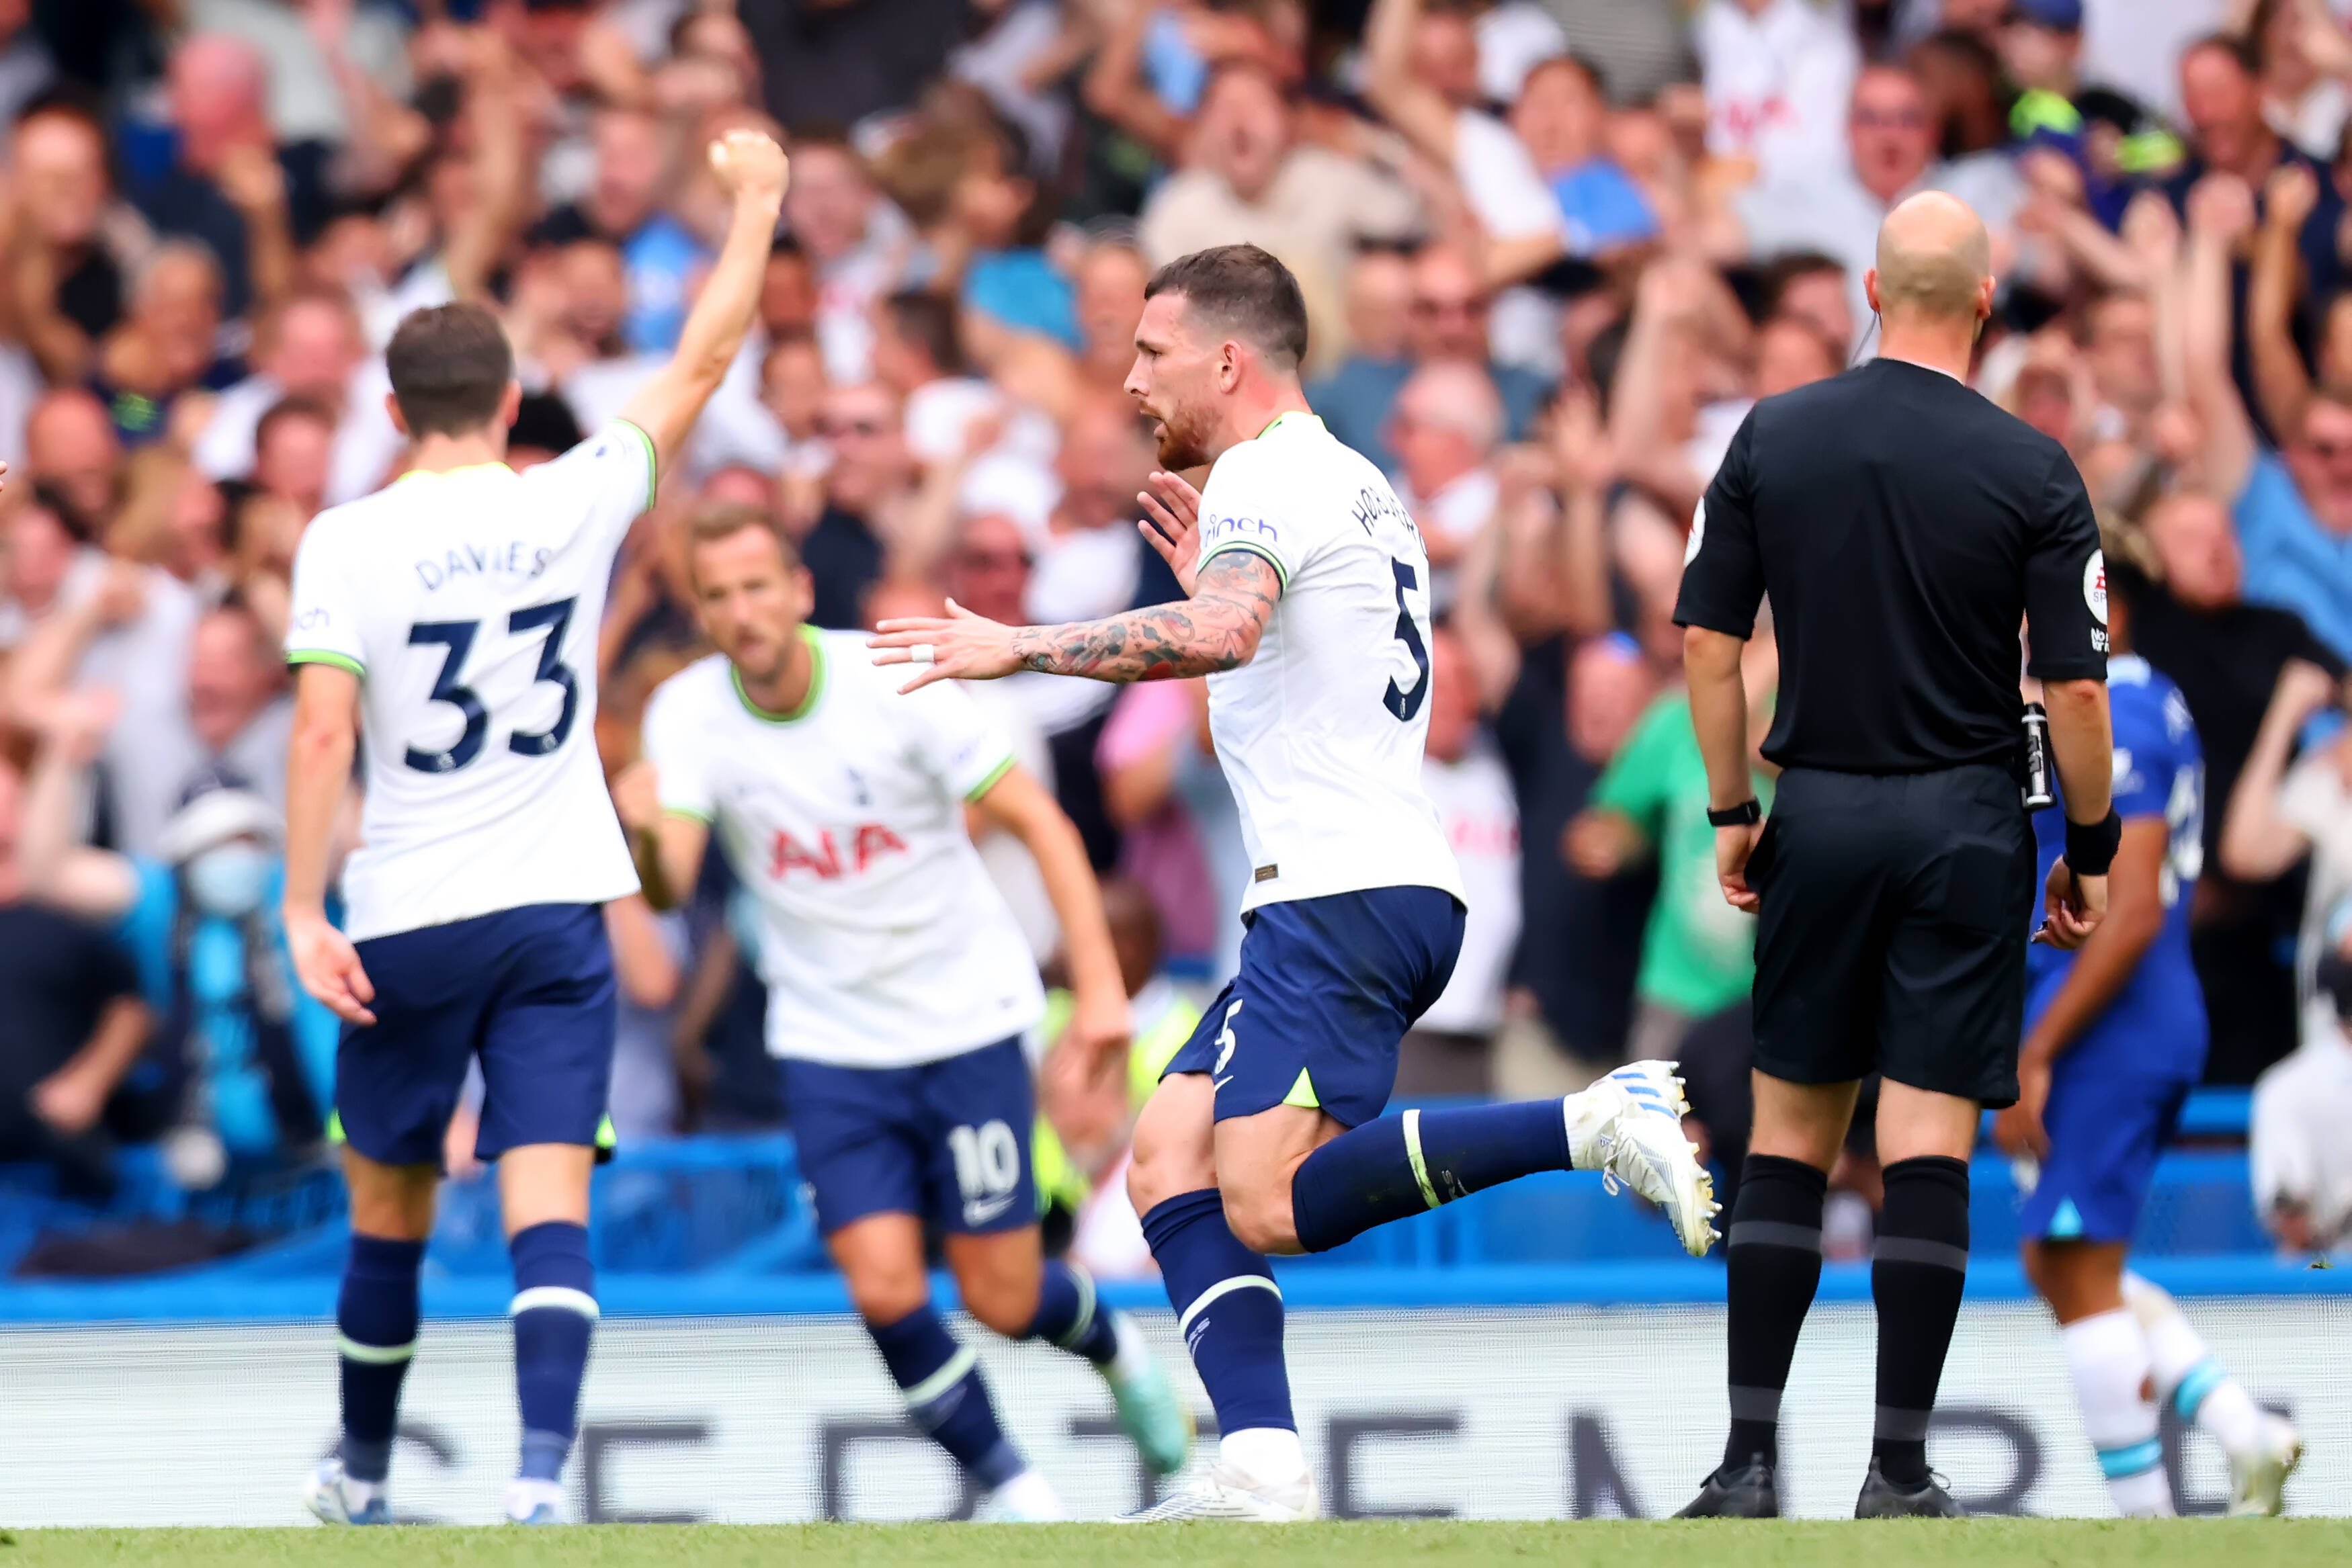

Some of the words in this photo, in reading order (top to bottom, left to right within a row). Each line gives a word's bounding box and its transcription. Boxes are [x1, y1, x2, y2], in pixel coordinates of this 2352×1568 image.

[415, 540, 552, 590] DAVIES
[1382, 556, 1429, 722] 5
[405, 593, 580, 773] 33
[770, 821, 909, 881] AIA
[1214, 998, 1243, 1075] 5
[948, 1120, 1020, 1199] 10
